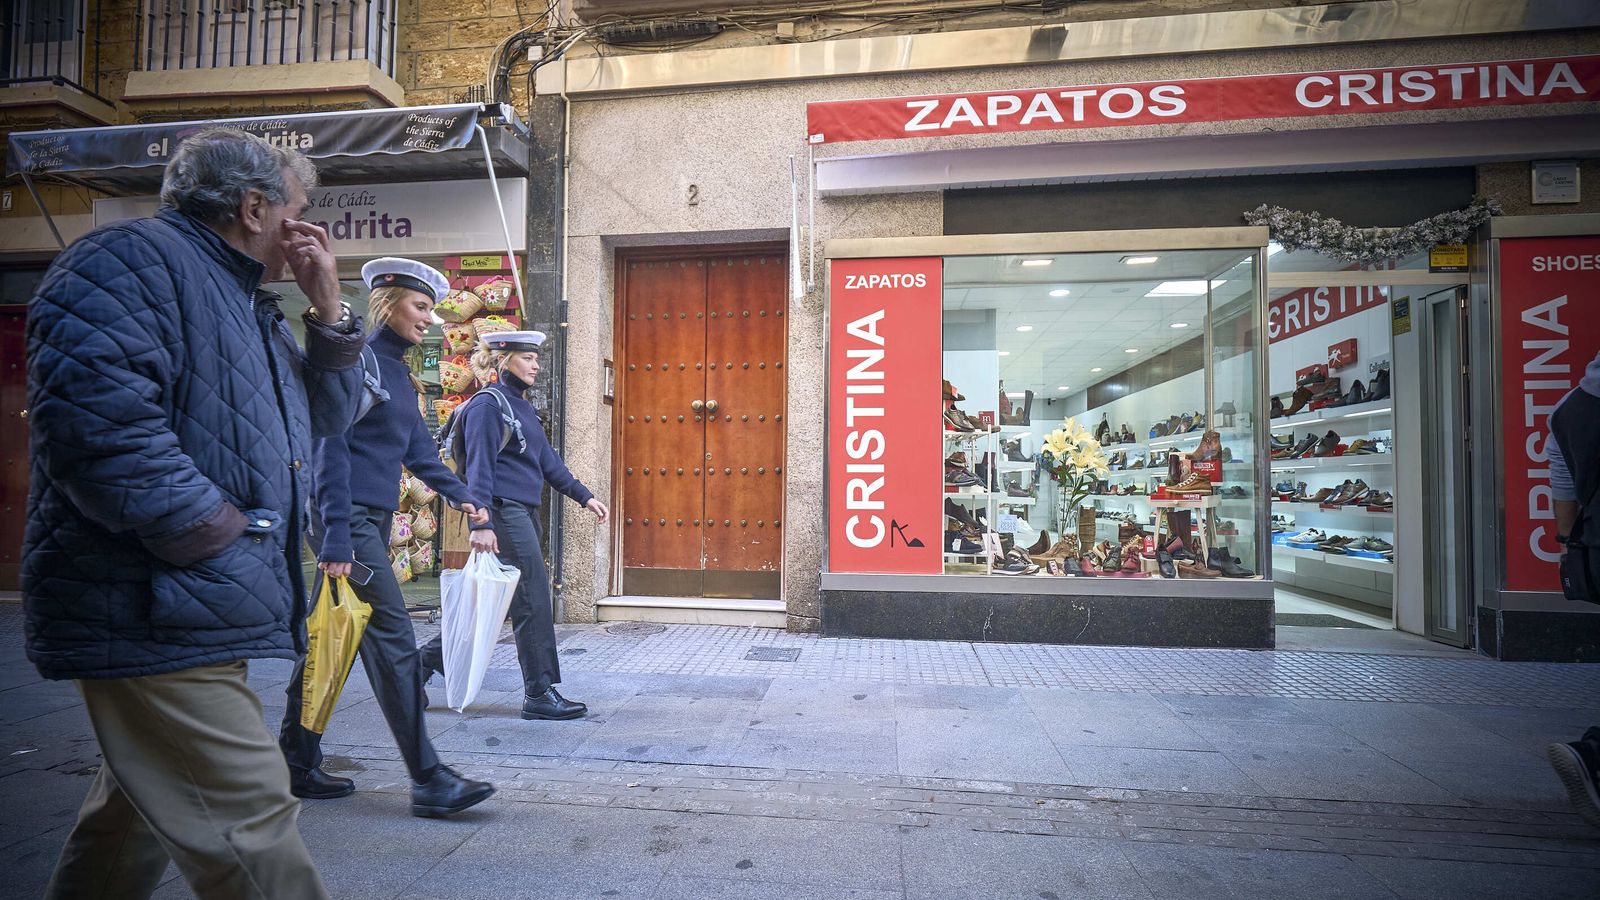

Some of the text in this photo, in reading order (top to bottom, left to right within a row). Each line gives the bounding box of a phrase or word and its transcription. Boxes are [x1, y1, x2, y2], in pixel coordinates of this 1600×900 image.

[904, 62, 1587, 131] ZAPATOS CRISTINA
[246, 122, 257, 131] de
[259, 119, 287, 131] Cádiz
[407, 113, 457, 128] Products of
[406, 125, 444, 138] the Sierra
[147, 137, 168, 157] el
[403, 138, 413, 147] de
[4, 194, 11, 207] 7
[319, 192, 333, 208] de
[338, 190, 376, 208] Cádiz
[688, 184, 699, 207] 2
[1532, 255, 1600, 272] SHOES
[845, 274, 926, 289] ZAPATOS
[845, 309, 885, 548] CRISTINA
